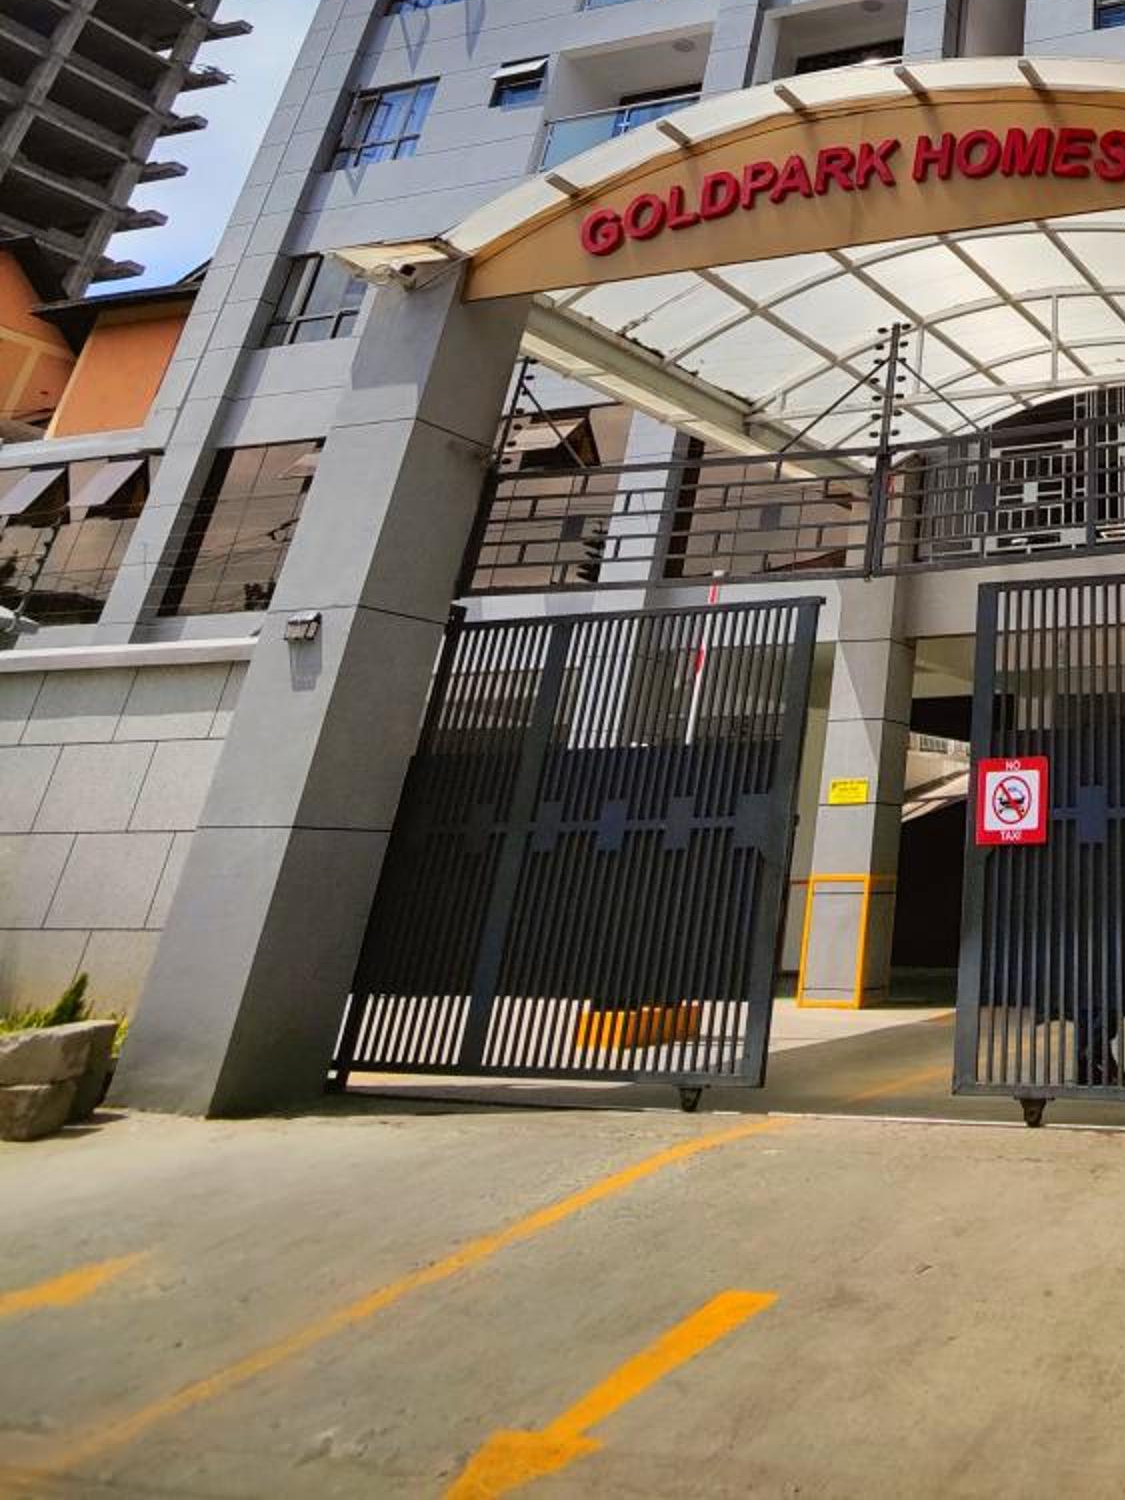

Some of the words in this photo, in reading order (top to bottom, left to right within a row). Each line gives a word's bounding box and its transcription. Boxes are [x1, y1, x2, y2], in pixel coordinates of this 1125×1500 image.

[579, 137, 900, 257] GOLDPARK
[1005, 760, 1021, 771] NO
[1001, 831, 1022, 841] TAXI
